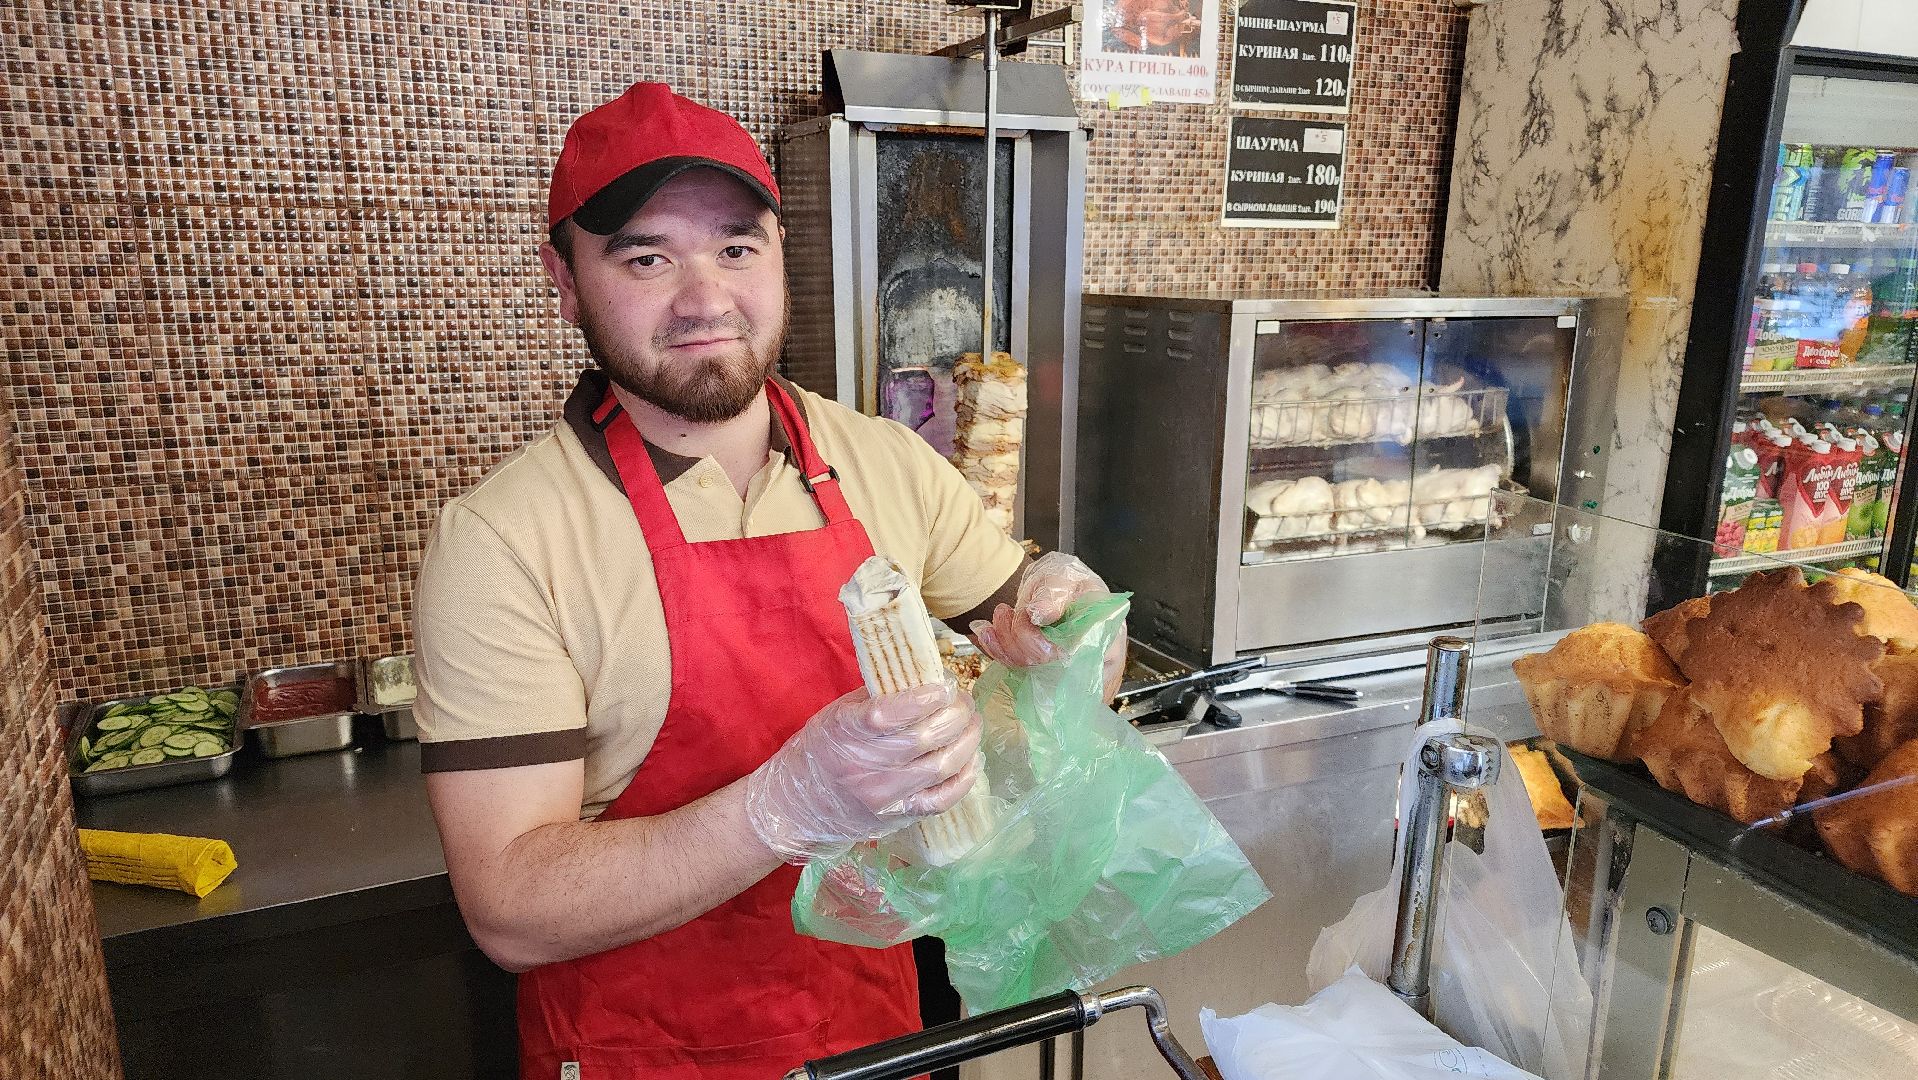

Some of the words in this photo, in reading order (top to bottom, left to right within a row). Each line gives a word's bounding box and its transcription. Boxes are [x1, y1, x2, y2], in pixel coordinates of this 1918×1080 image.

[1238, 16, 1325, 34] МИНИ-ШАУРМА
[1239, 44, 1299, 60] КУРИНАЯ
[1085, 58, 1124, 74] КУРА
[1129, 60, 1176, 76] ГРИЛЬ
[1236, 135, 1299, 153] ШАУРМА
[1231, 170, 1285, 184] КУРИНАЯ
